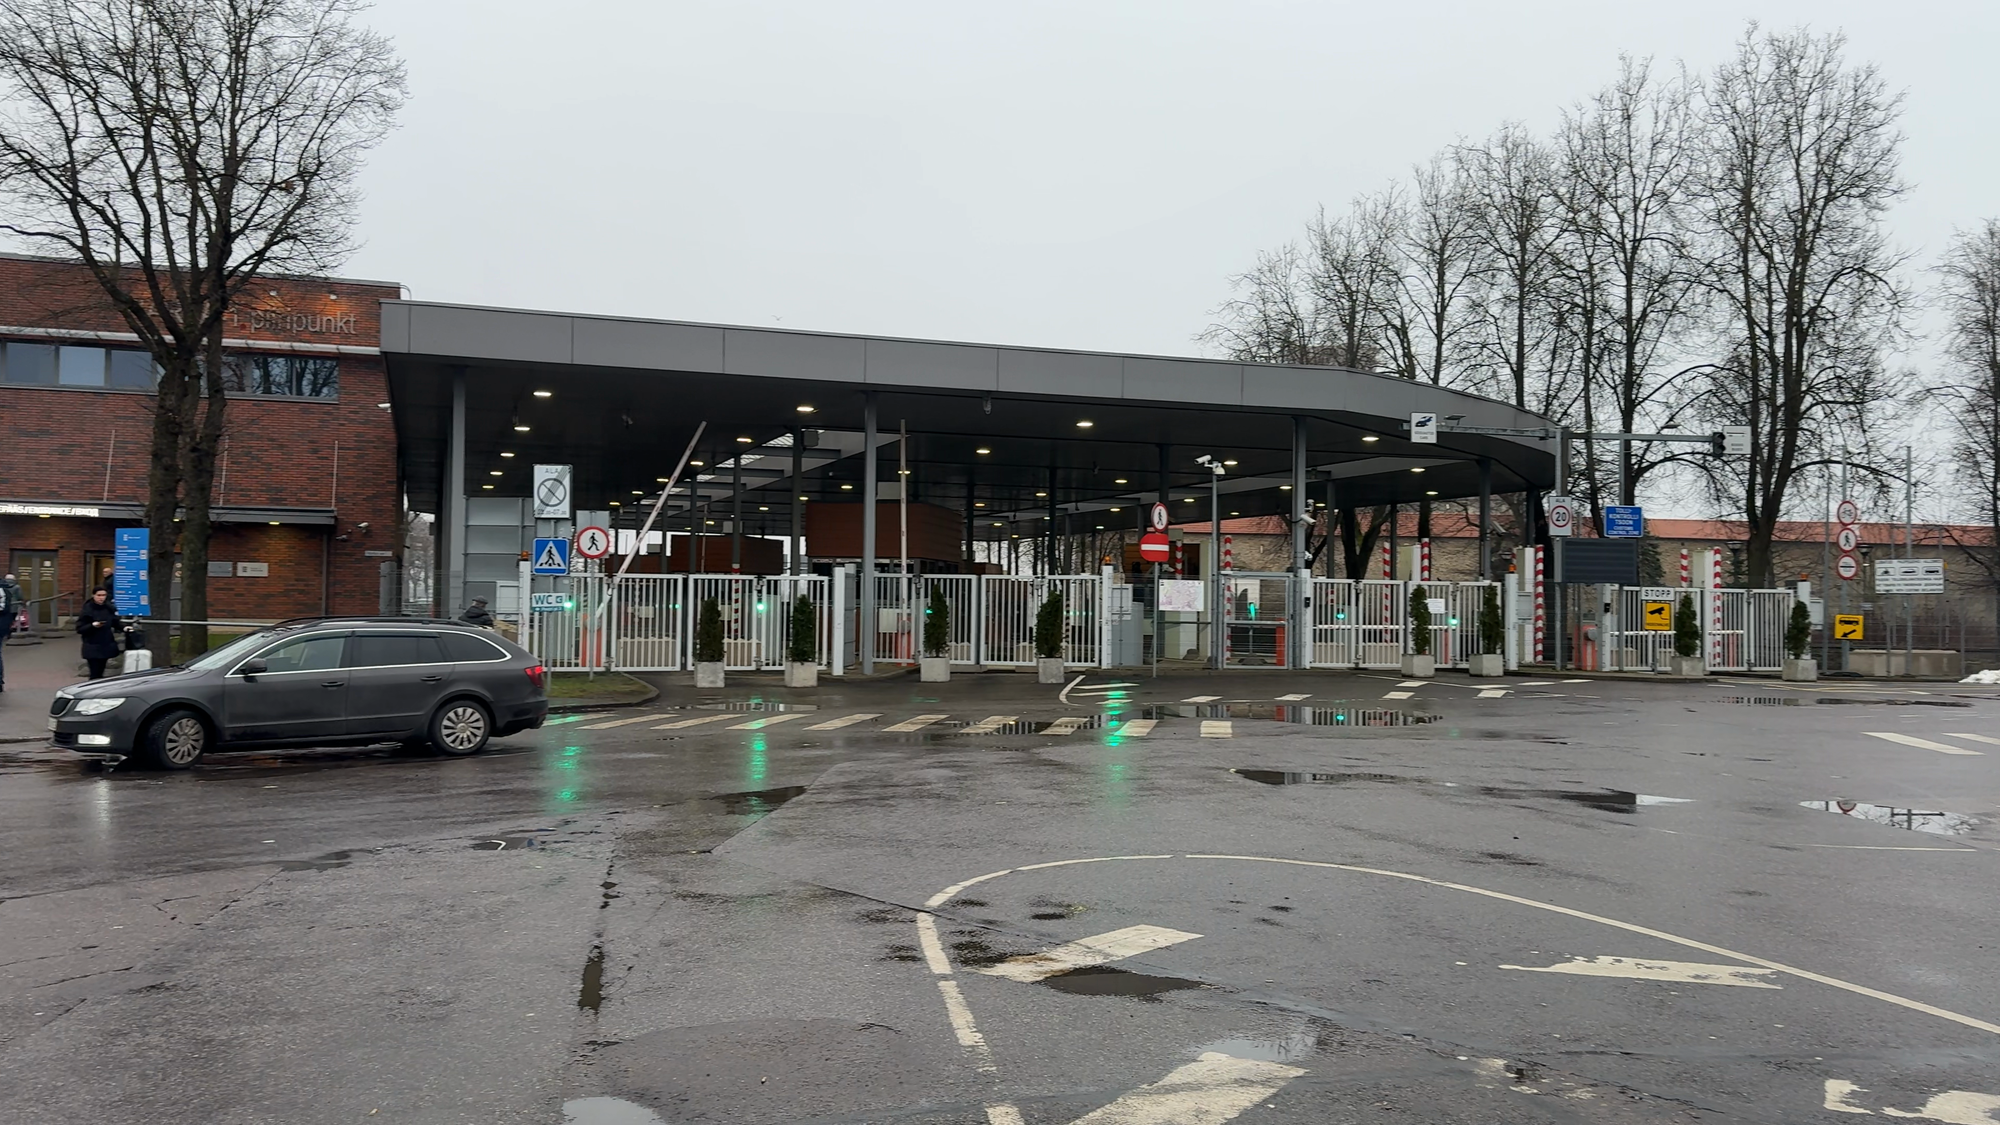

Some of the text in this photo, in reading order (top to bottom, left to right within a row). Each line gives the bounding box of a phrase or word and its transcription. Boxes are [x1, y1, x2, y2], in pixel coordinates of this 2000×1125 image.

[1555, 511, 1566, 522] 20
[1644, 589, 1671, 598] STOPP
[534, 594, 553, 605] WC
